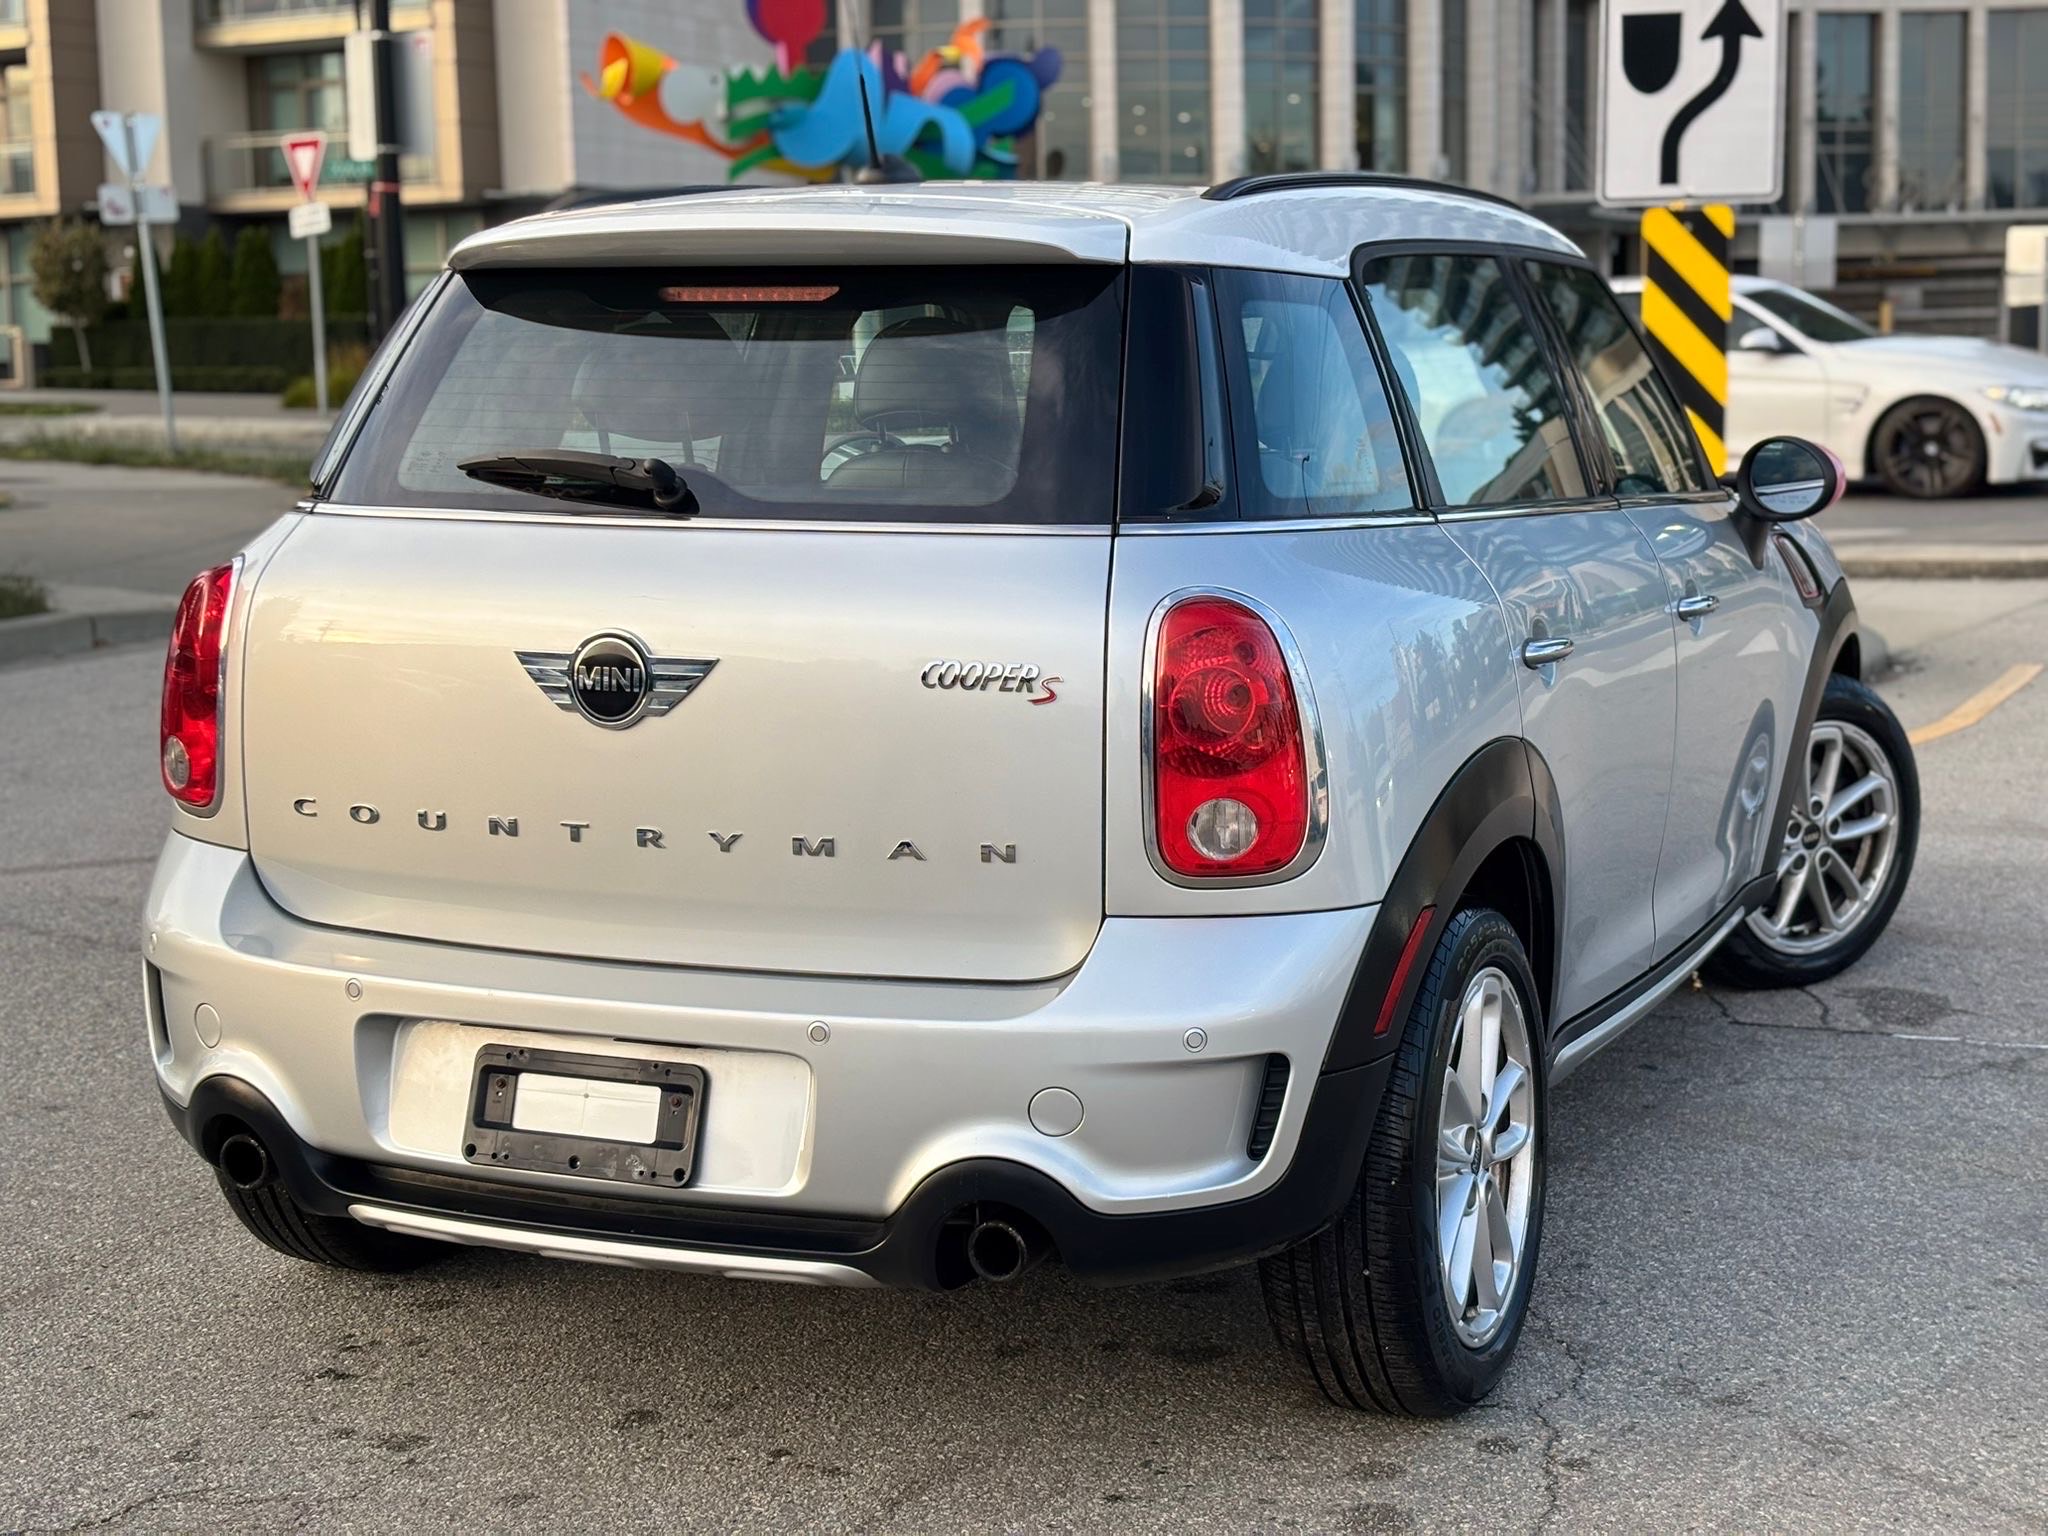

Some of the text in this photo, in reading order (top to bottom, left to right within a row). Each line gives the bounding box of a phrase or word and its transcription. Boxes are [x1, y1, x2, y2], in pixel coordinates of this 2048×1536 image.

[578, 665, 640, 693] MINI
[921, 660, 1064, 706] COOPER S
[293, 797, 1017, 864] COUNTRYMAN
